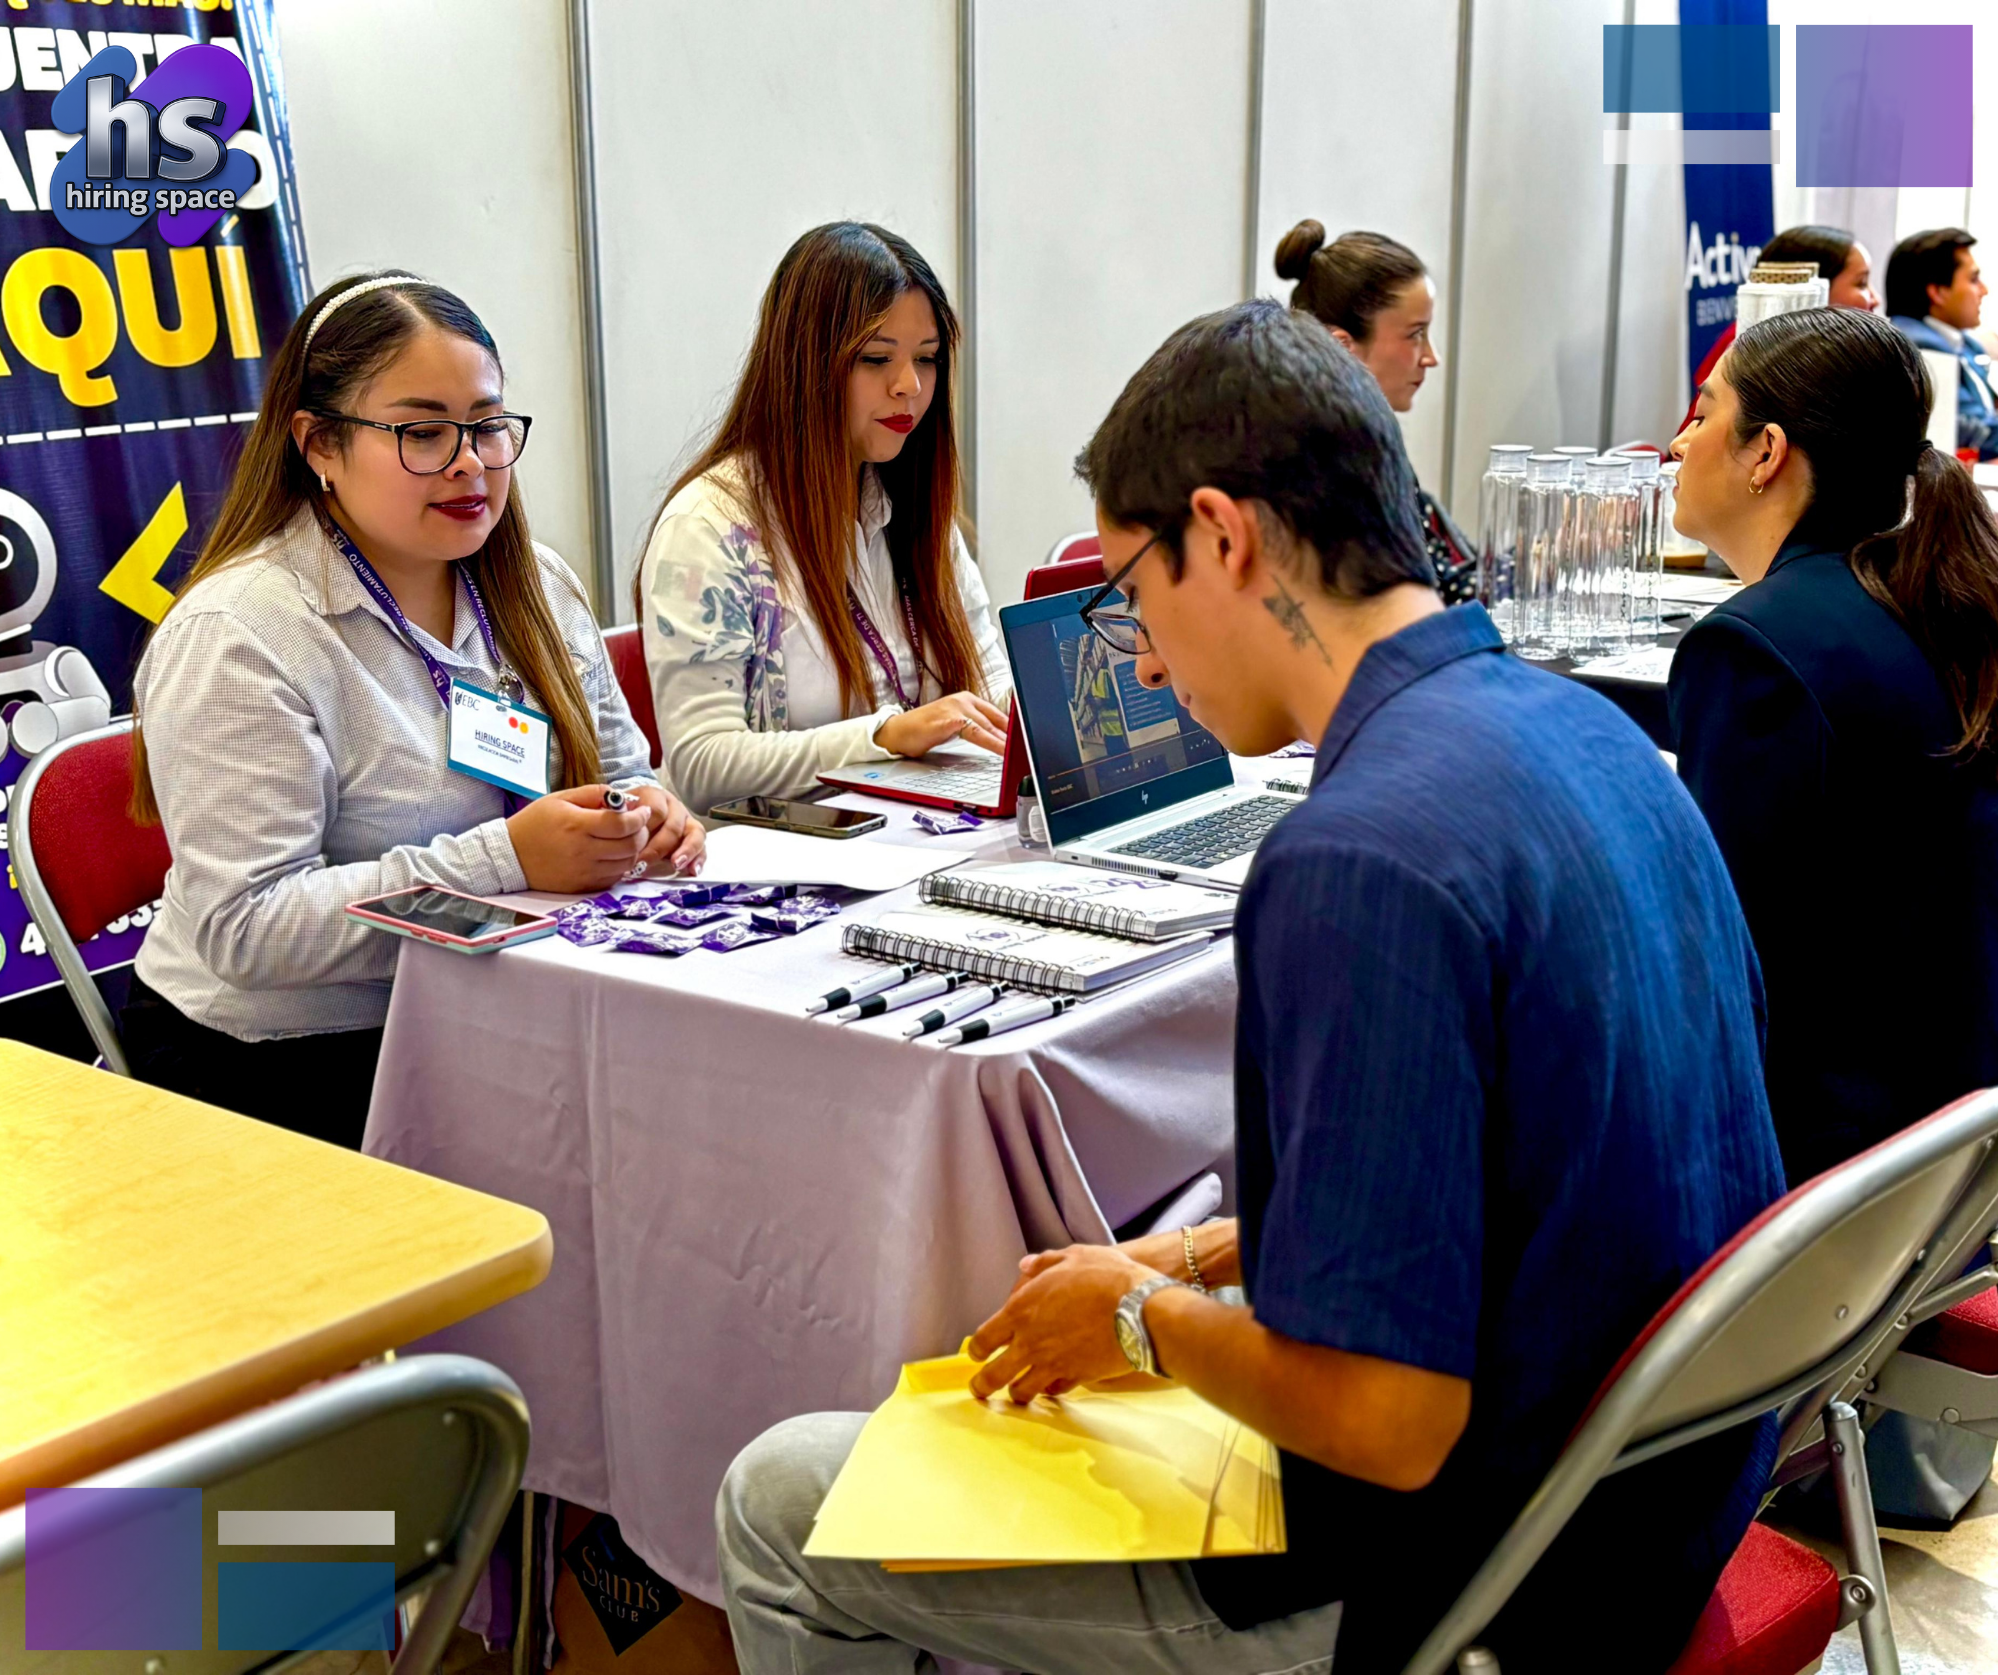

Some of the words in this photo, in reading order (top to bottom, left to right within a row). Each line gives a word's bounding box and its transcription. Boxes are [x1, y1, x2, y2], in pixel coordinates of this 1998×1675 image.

[1684, 221, 1762, 290] Activ
[0, 214, 262, 407] QUÍ
[475, 729, 501, 747] HIRING
[502, 740, 525, 757] SPACE
[582, 1546, 660, 1612] Sam's
